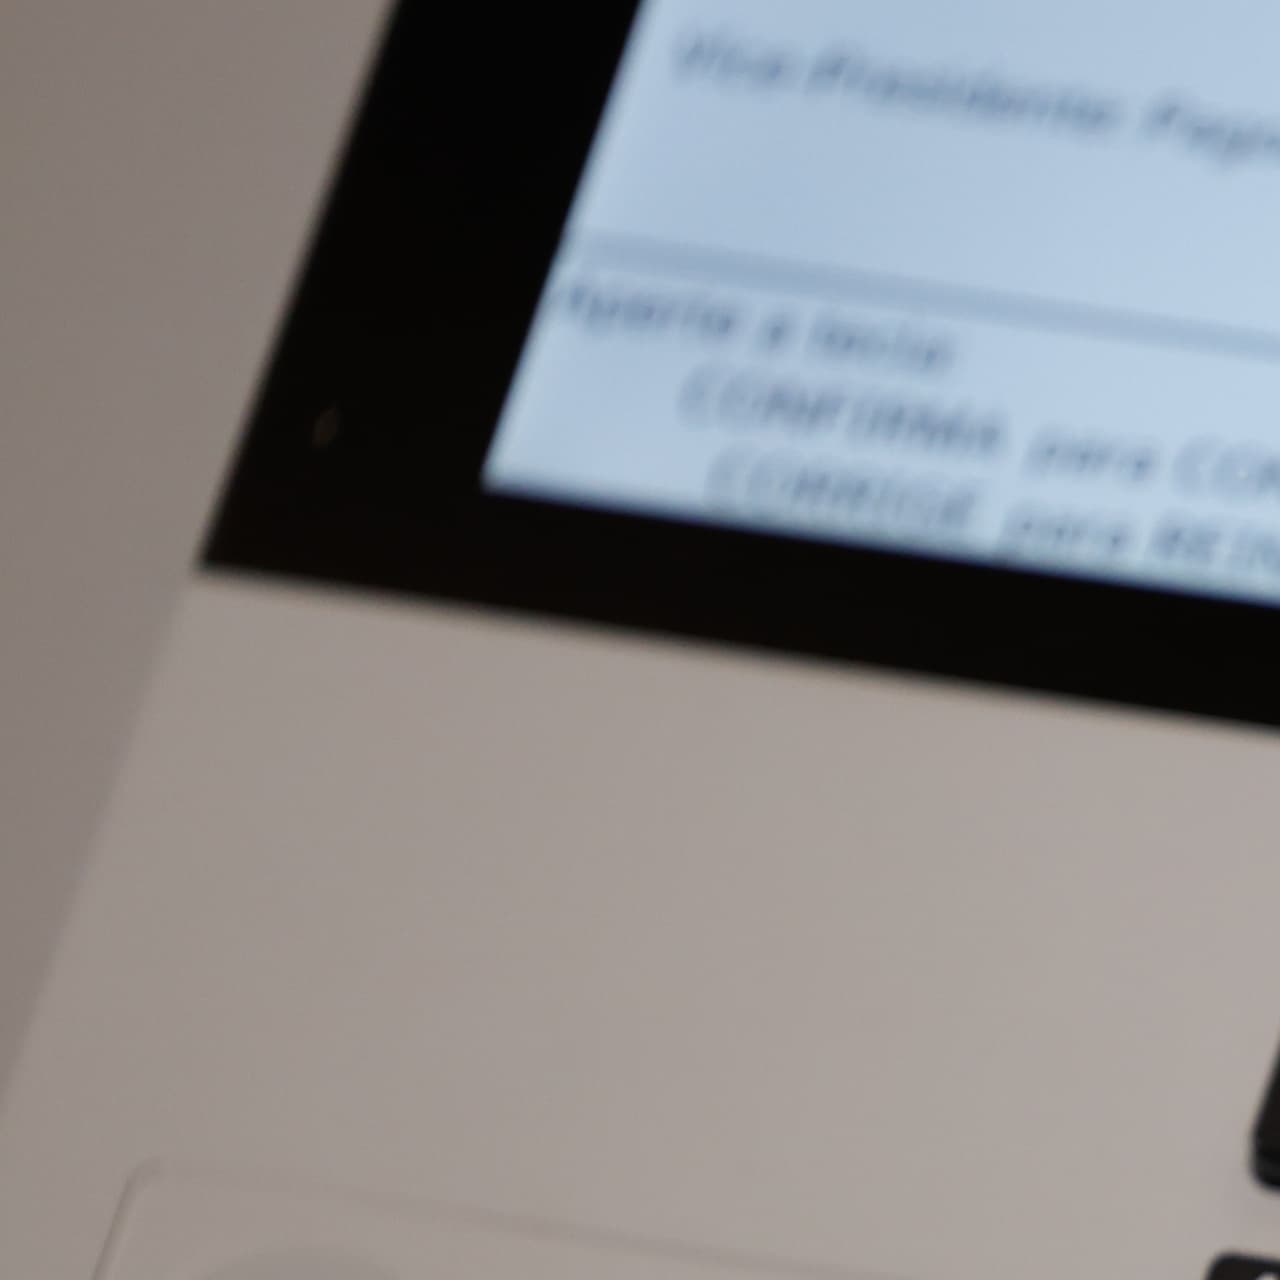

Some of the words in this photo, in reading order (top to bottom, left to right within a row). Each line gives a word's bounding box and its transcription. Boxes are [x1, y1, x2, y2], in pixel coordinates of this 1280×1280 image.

[678, 362, 1010, 464] CONFIRMA
[1026, 424, 1162, 486] para
[1002, 500, 1138, 564] para
